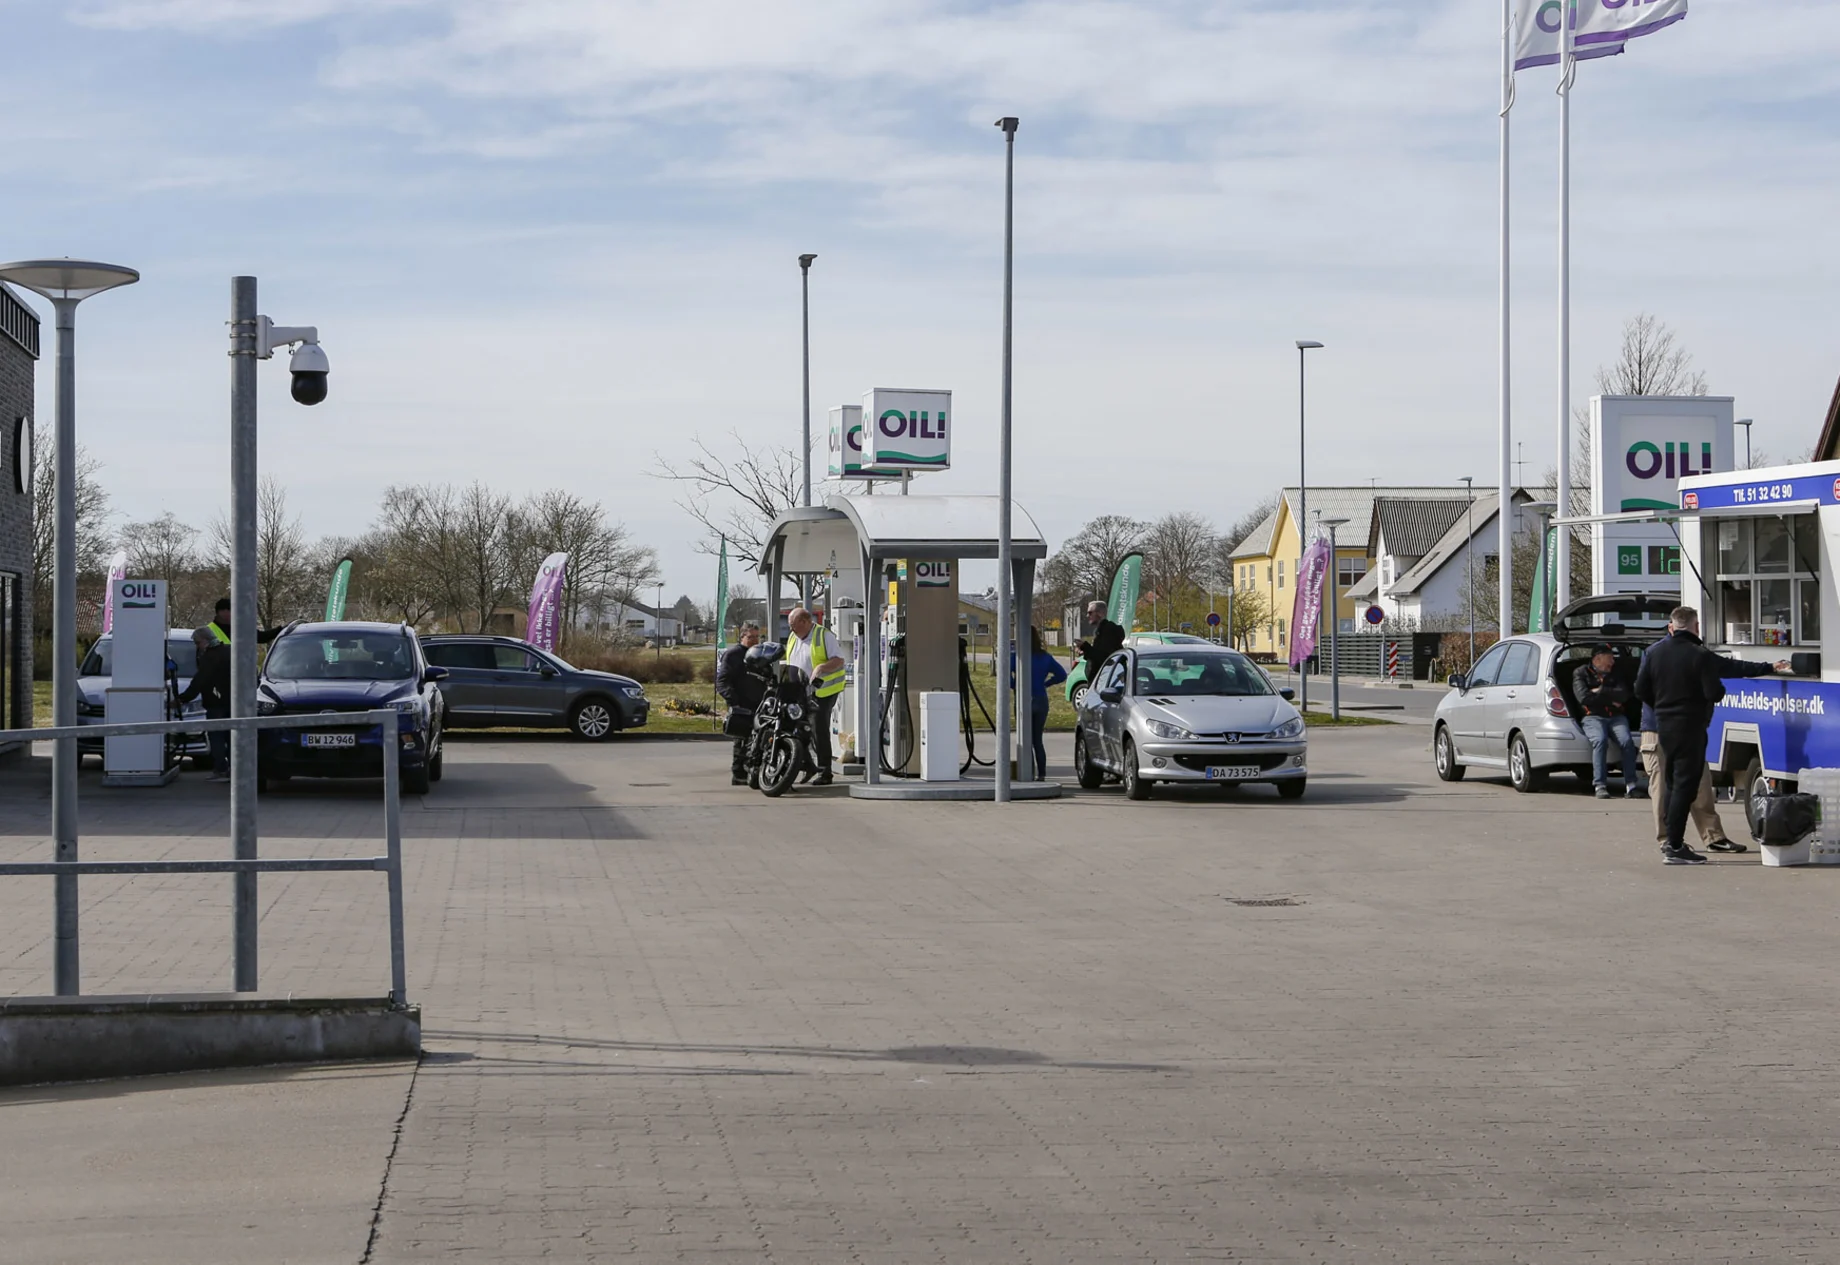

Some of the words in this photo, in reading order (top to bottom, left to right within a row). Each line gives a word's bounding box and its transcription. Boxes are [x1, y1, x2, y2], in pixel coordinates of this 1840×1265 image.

[1535, 0, 1576, 33] OI
[879, 409, 945, 439] OIL!
[1626, 441, 1711, 479] OIL!
[1747, 487, 1756, 501] 51
[1758, 486, 1768, 500] 32
[1770, 485, 1780, 499] 42
[1782, 484, 1792, 498] 90
[1621, 554, 1639, 566] 95
[832, 570, 838, 578] 4
[916, 562, 950, 577] OIL!
[122, 584, 155, 598] OIL!
[1118, 563, 1130, 625] alitetskunde
[1714, 690, 1824, 716] ww.kelds-polser.dk
[308, 735, 321, 744] BW
[323, 735, 334, 744] 12
[336, 735, 354, 744] 946
[1213, 768, 1226, 777] DA
[1228, 768, 1239, 777] 73
[1241, 767, 1259, 777] 575
